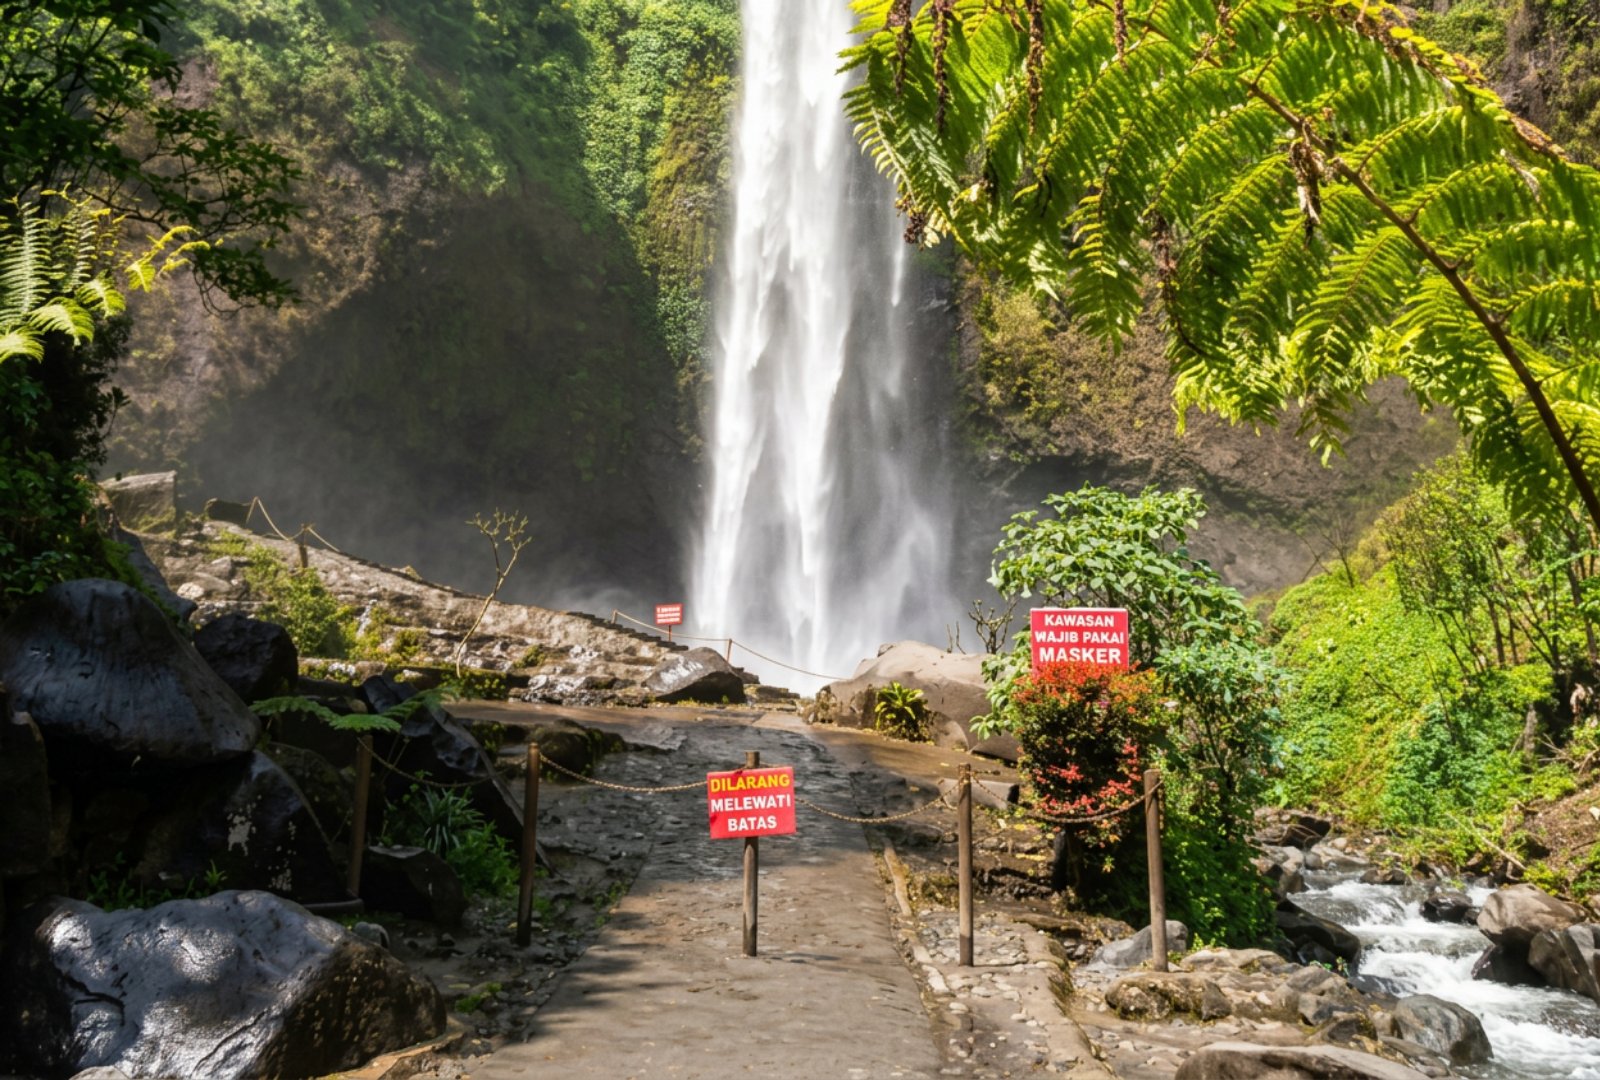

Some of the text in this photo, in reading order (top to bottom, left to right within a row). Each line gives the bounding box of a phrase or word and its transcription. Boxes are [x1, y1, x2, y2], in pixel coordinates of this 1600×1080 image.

[1044, 614, 1114, 627] KAWASAN
[1035, 631, 1124, 644] WAJIB PAKAI
[1039, 647, 1121, 664] MASKER
[710, 774, 790, 792] DILARANG
[711, 794, 791, 813] MELEWATI
[728, 815, 777, 832] BATAS
